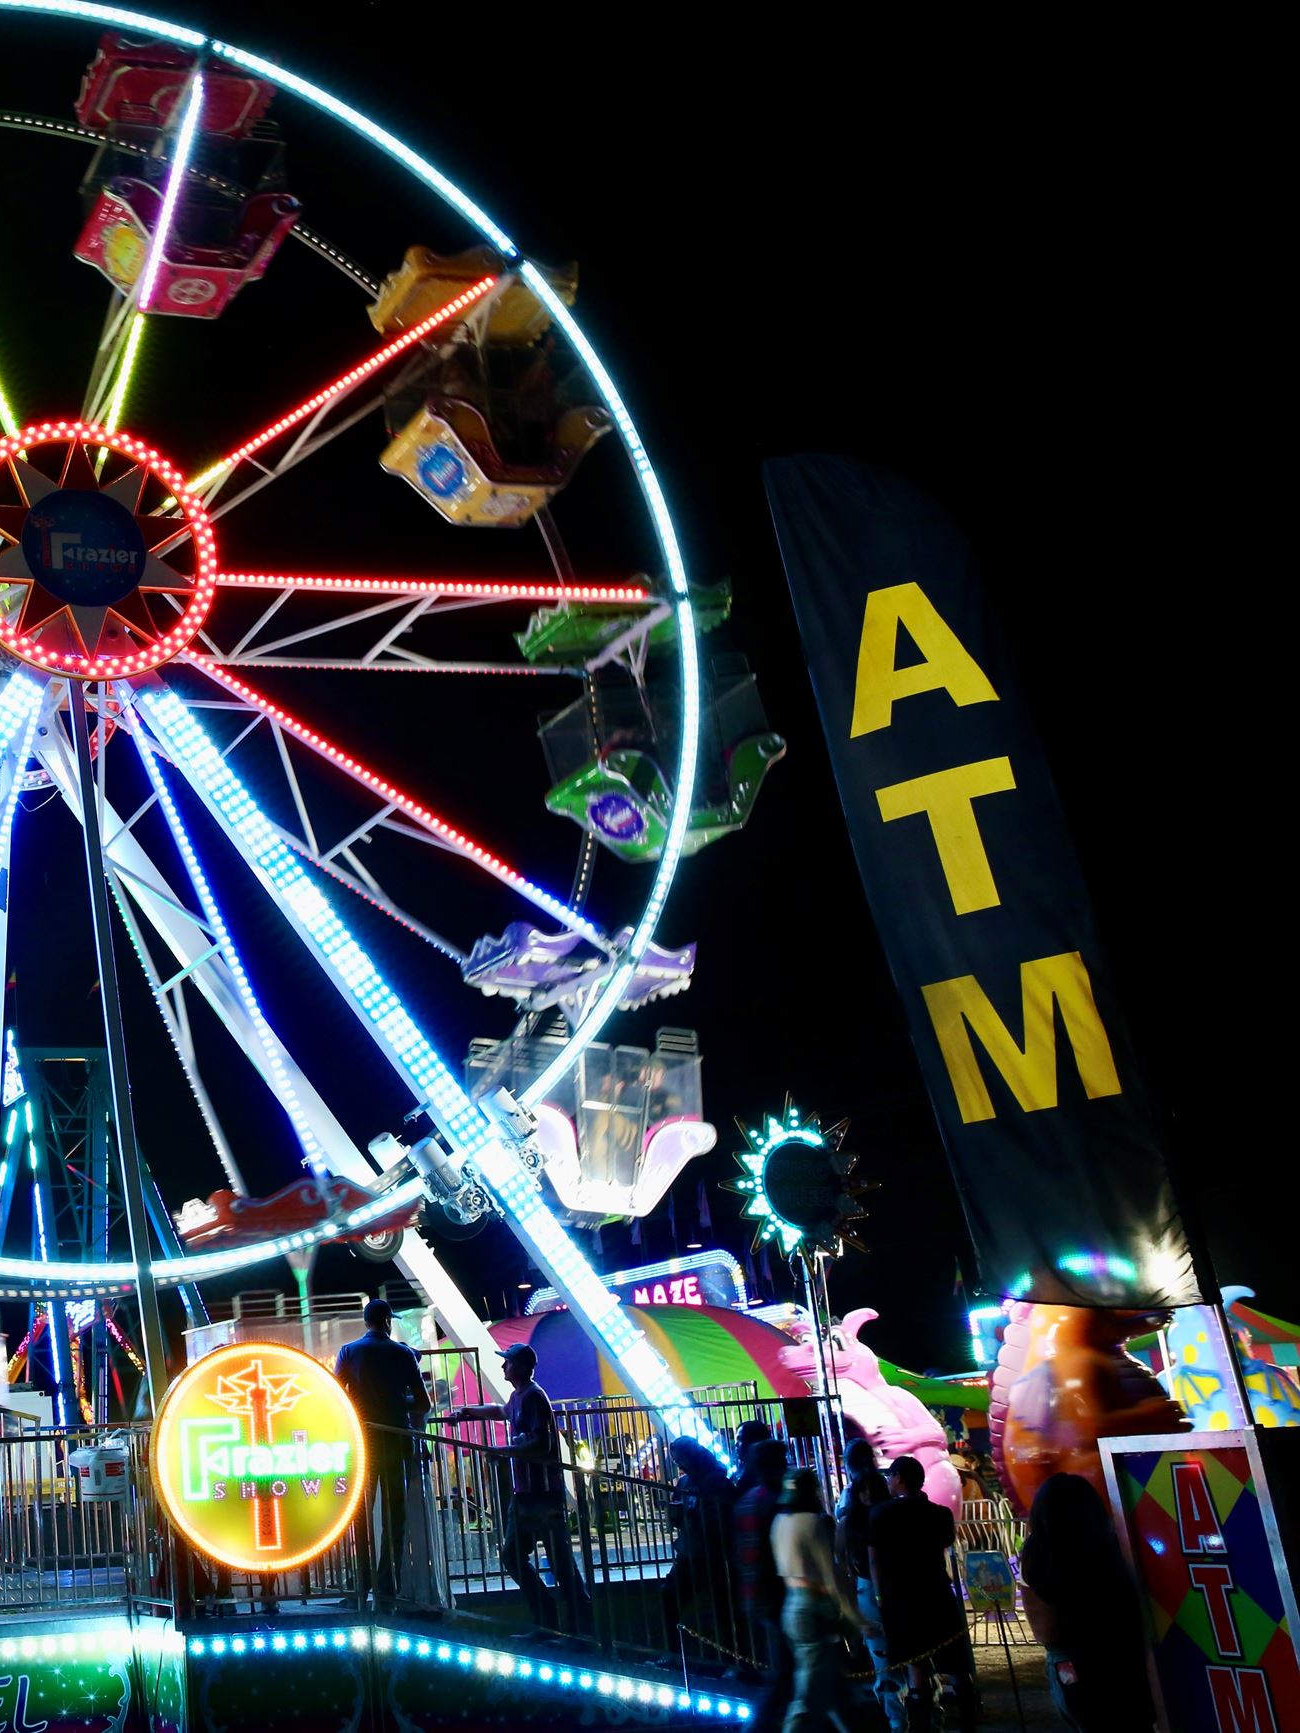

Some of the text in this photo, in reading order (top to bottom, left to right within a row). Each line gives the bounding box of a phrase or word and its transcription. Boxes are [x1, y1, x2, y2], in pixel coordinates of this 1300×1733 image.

[50, 532, 138, 570] Frazier
[850, 581, 1122, 1124] ATM
[635, 1276, 702, 1305] MAZE
[180, 1417, 350, 1501] Frazier
[213, 1476, 348, 1500] SHOWS
[1172, 1464, 1277, 1733] ATM
